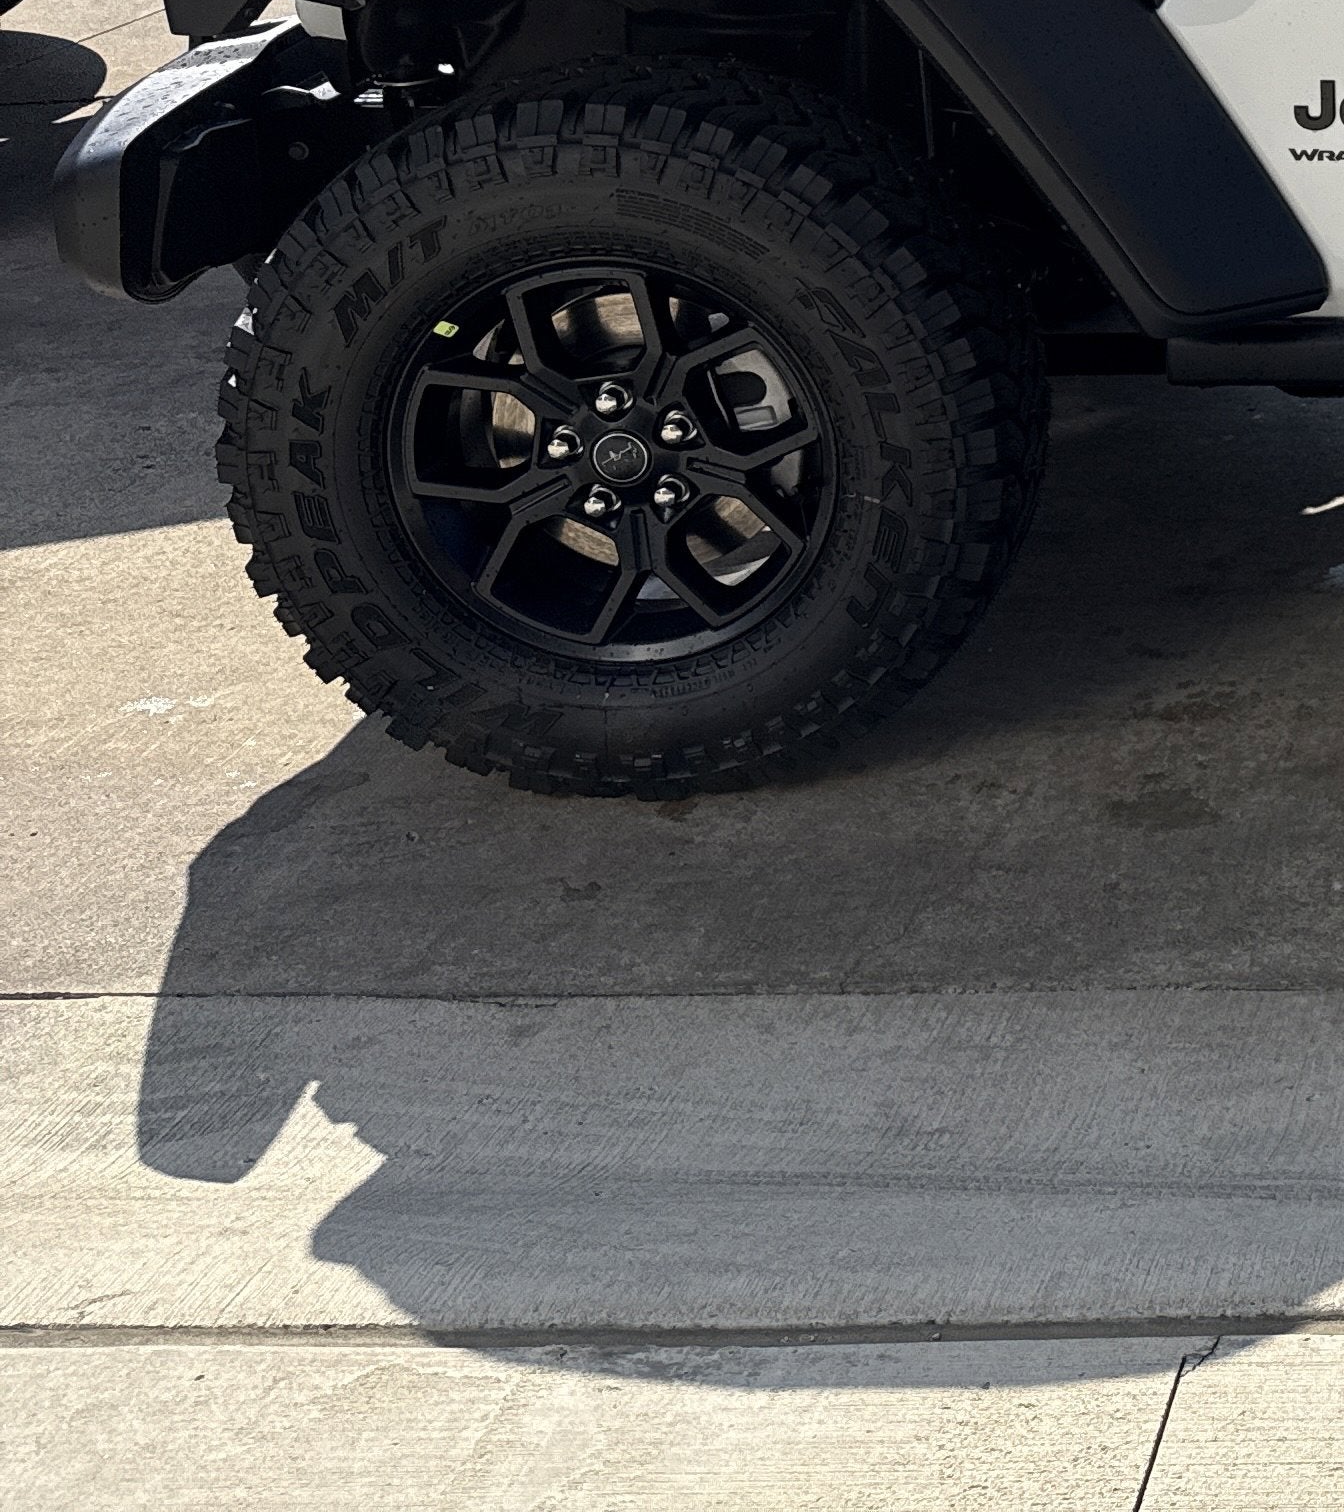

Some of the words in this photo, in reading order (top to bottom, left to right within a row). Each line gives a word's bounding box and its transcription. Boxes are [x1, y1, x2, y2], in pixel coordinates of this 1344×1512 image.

[331, 215, 448, 349] M/T
[793, 275, 914, 629] FALKEN
[288, 365, 567, 737] WILDPEAK
